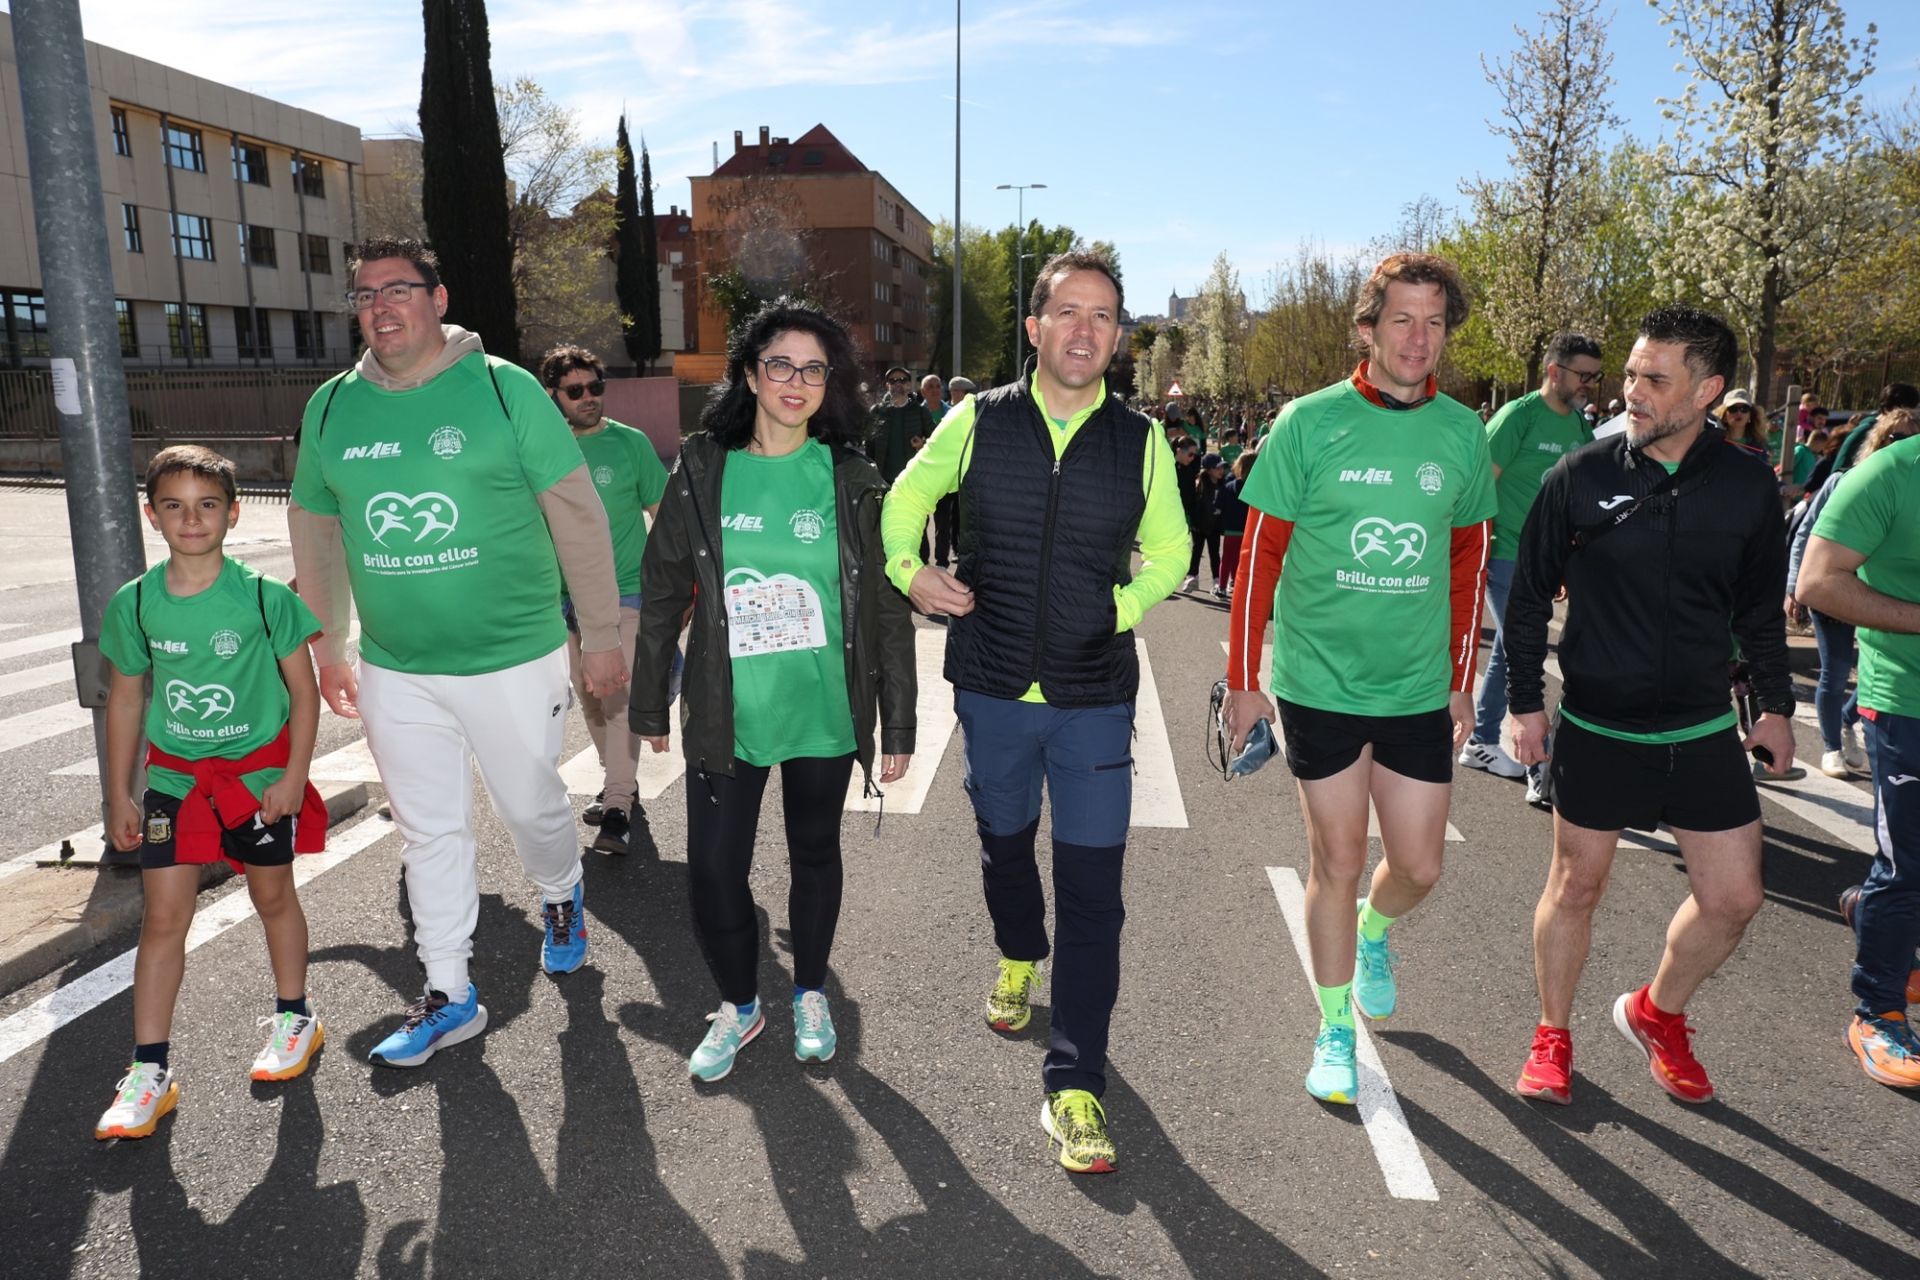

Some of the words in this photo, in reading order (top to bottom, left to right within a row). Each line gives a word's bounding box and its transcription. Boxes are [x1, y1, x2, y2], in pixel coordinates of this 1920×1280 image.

[343, 442, 402, 460] INAEL
[1339, 467, 1393, 484] INAEL
[363, 553, 401, 568] Brilla
[404, 554, 434, 567] con
[438, 546, 479, 563] ellos
[1336, 569, 1376, 586] Brilla
[1379, 577, 1402, 587] con
[1405, 574, 1430, 588] ellos
[192, 728, 214, 738] con
[217, 723, 250, 737] ellos
